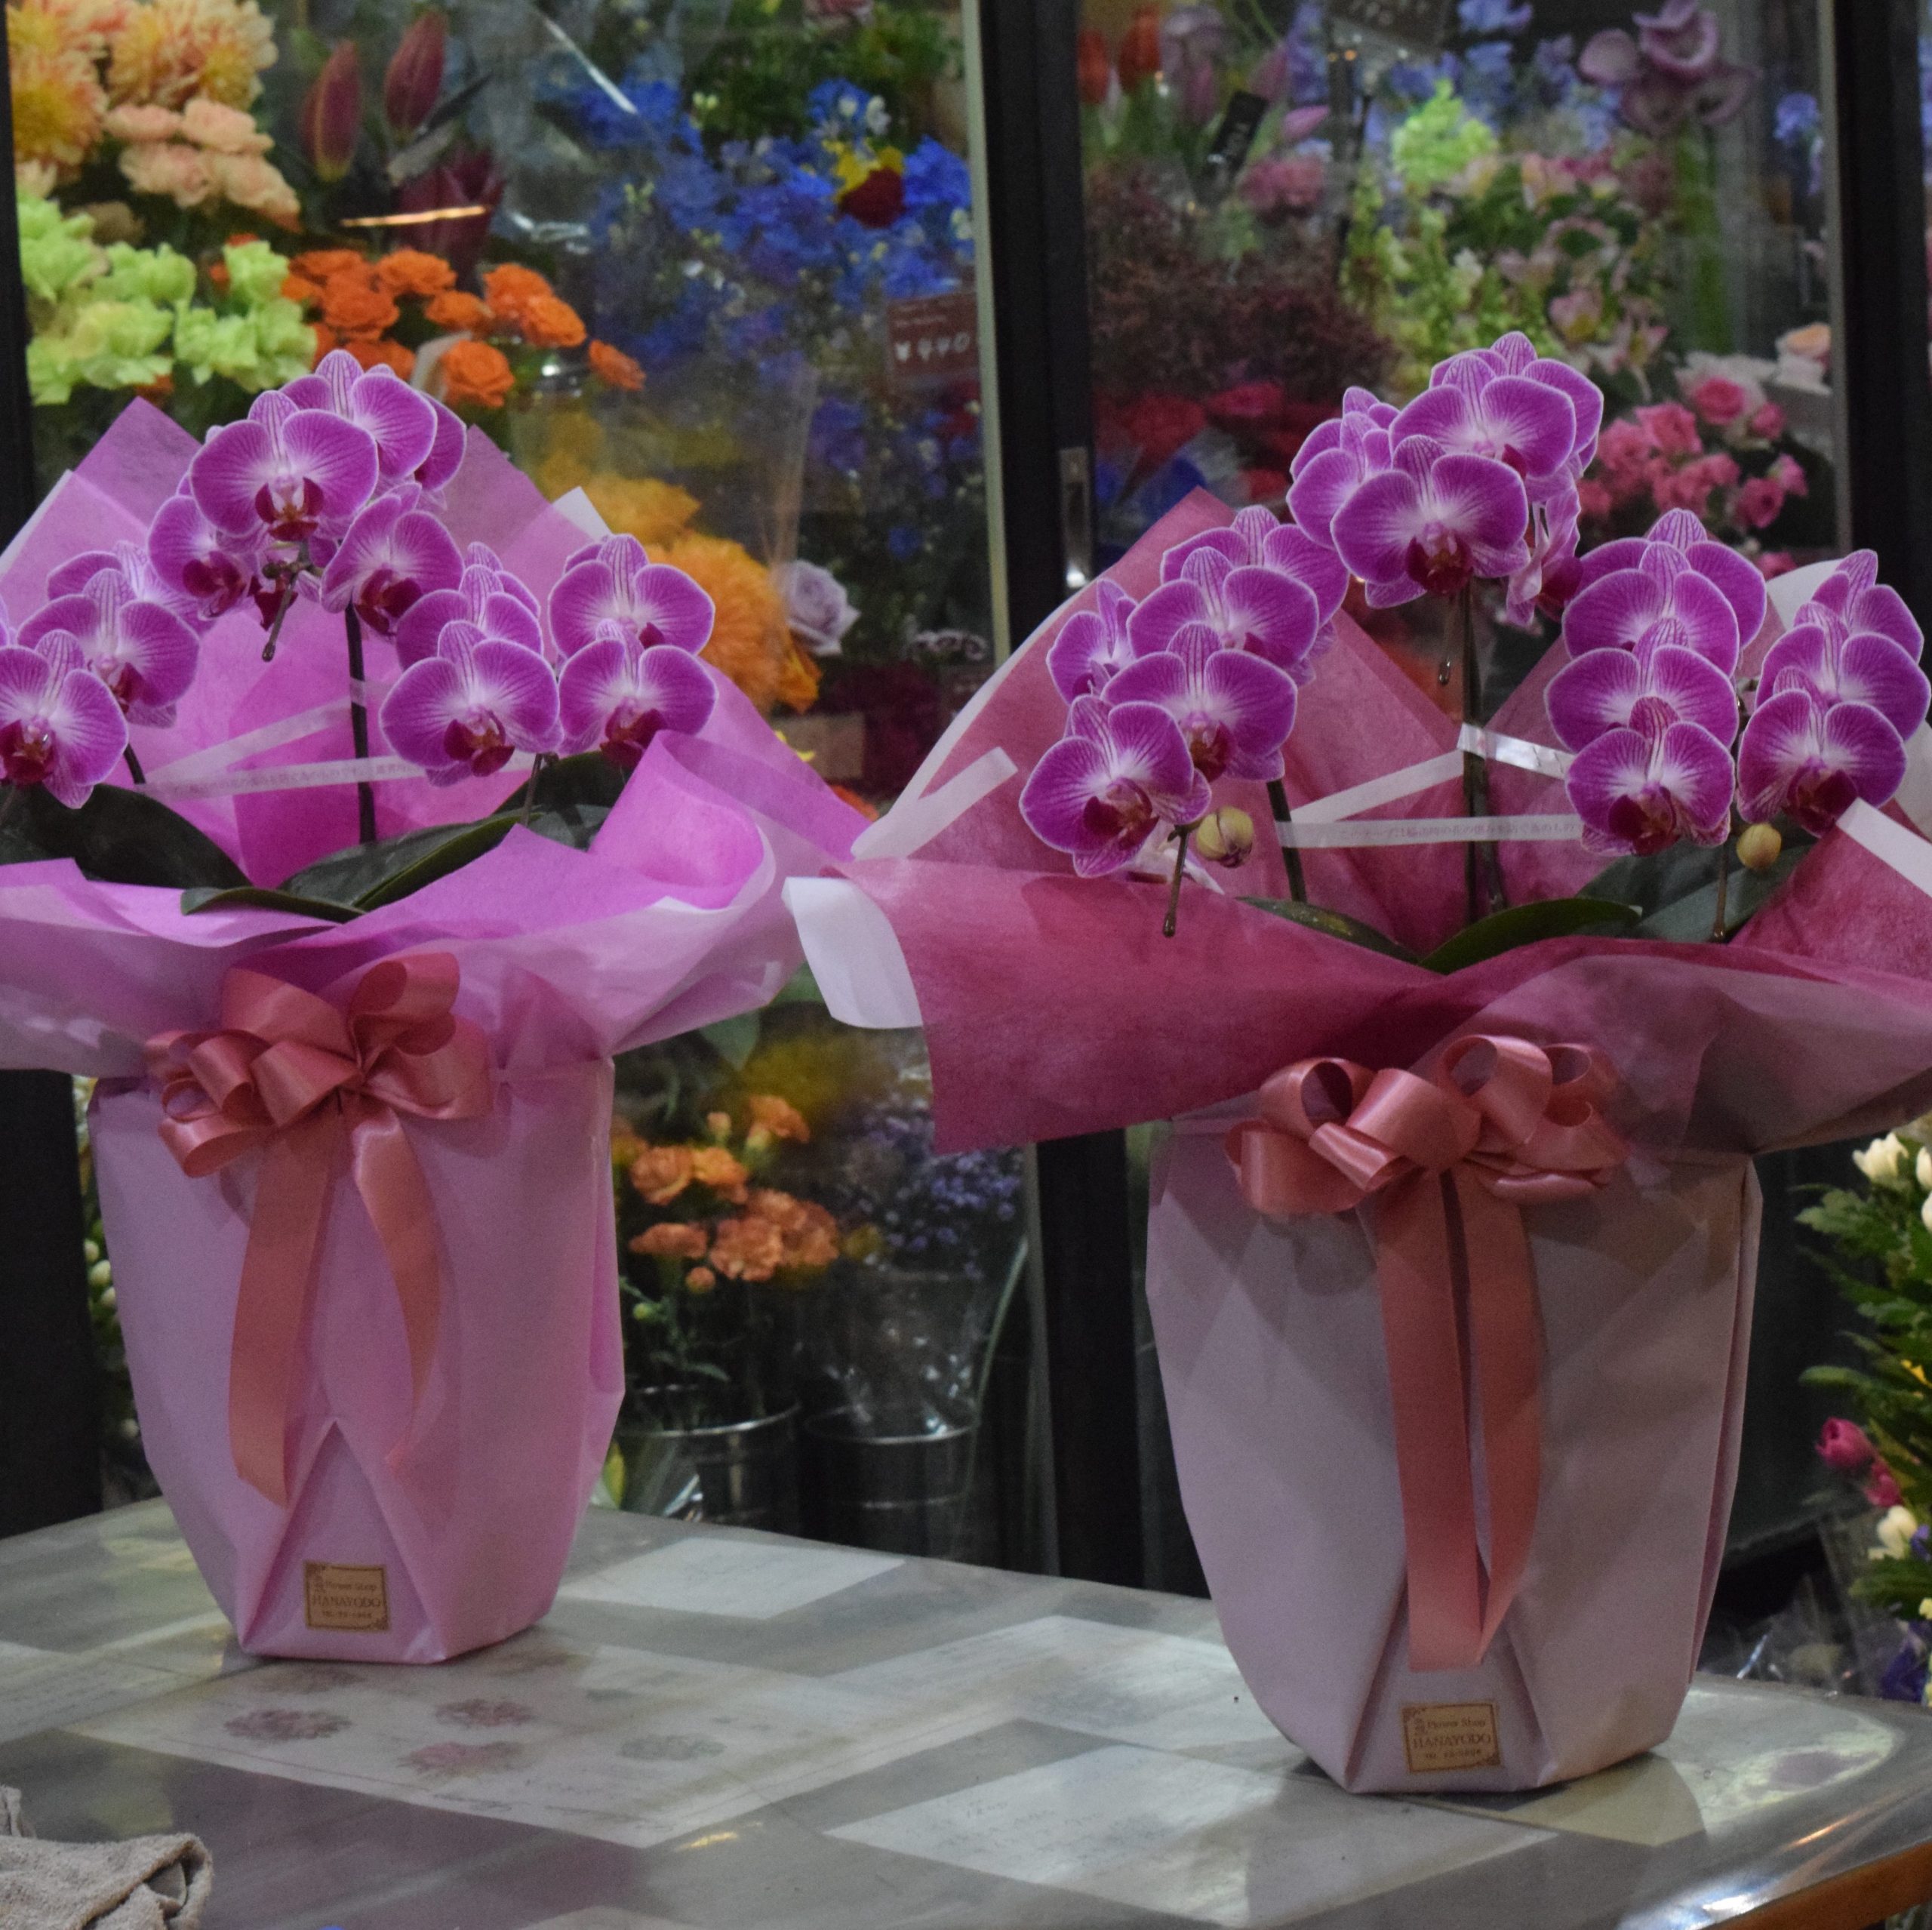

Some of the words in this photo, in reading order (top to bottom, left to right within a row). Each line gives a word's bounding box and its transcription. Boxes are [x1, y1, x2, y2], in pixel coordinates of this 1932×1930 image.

[313, 1594, 381, 1607] HANAYODO
[1460, 1716, 1487, 1728] Shop
[1412, 1732, 1491, 1749] HANAYODO
